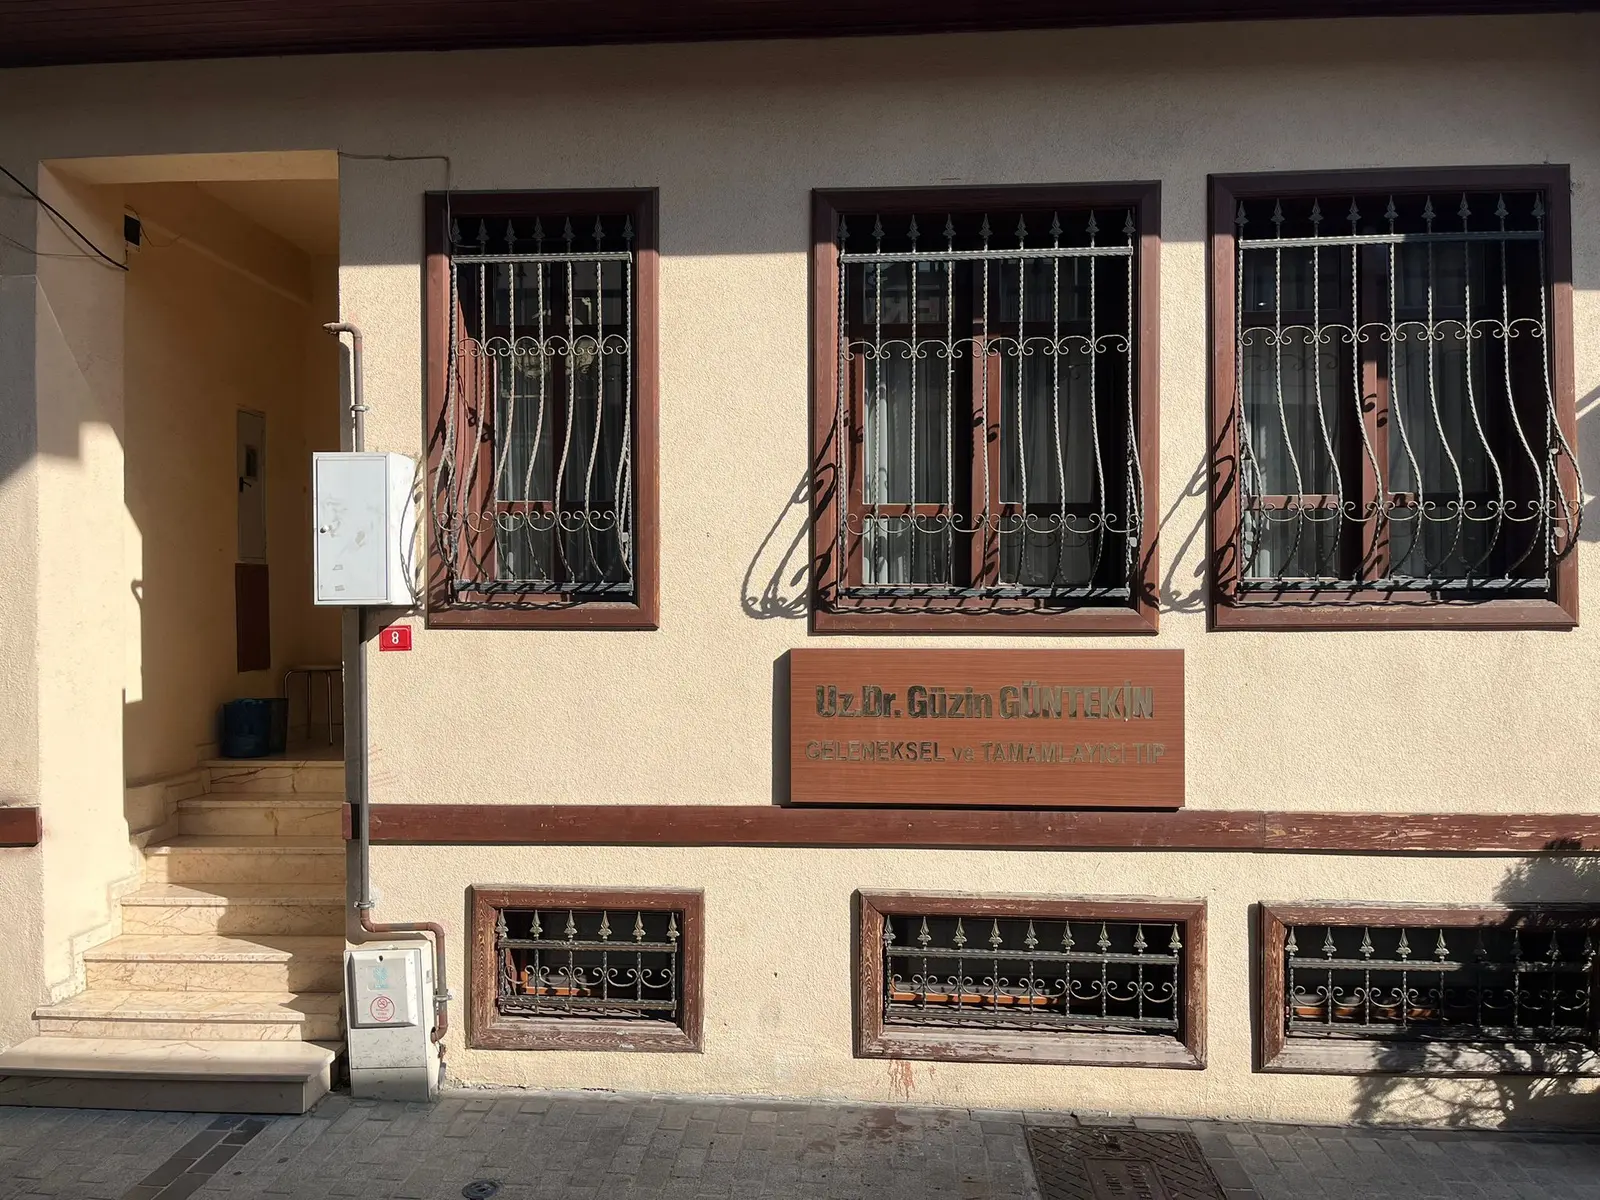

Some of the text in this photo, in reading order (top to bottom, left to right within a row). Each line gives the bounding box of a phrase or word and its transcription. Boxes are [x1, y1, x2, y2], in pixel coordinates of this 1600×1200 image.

[391, 631, 399, 644] 8
[815, 680, 1154, 719] Uz.Dr. Güzin GÜNTEKİN
[805, 740, 1167, 764] GELENEKSEL ve TAMAMLAYICI TIP
